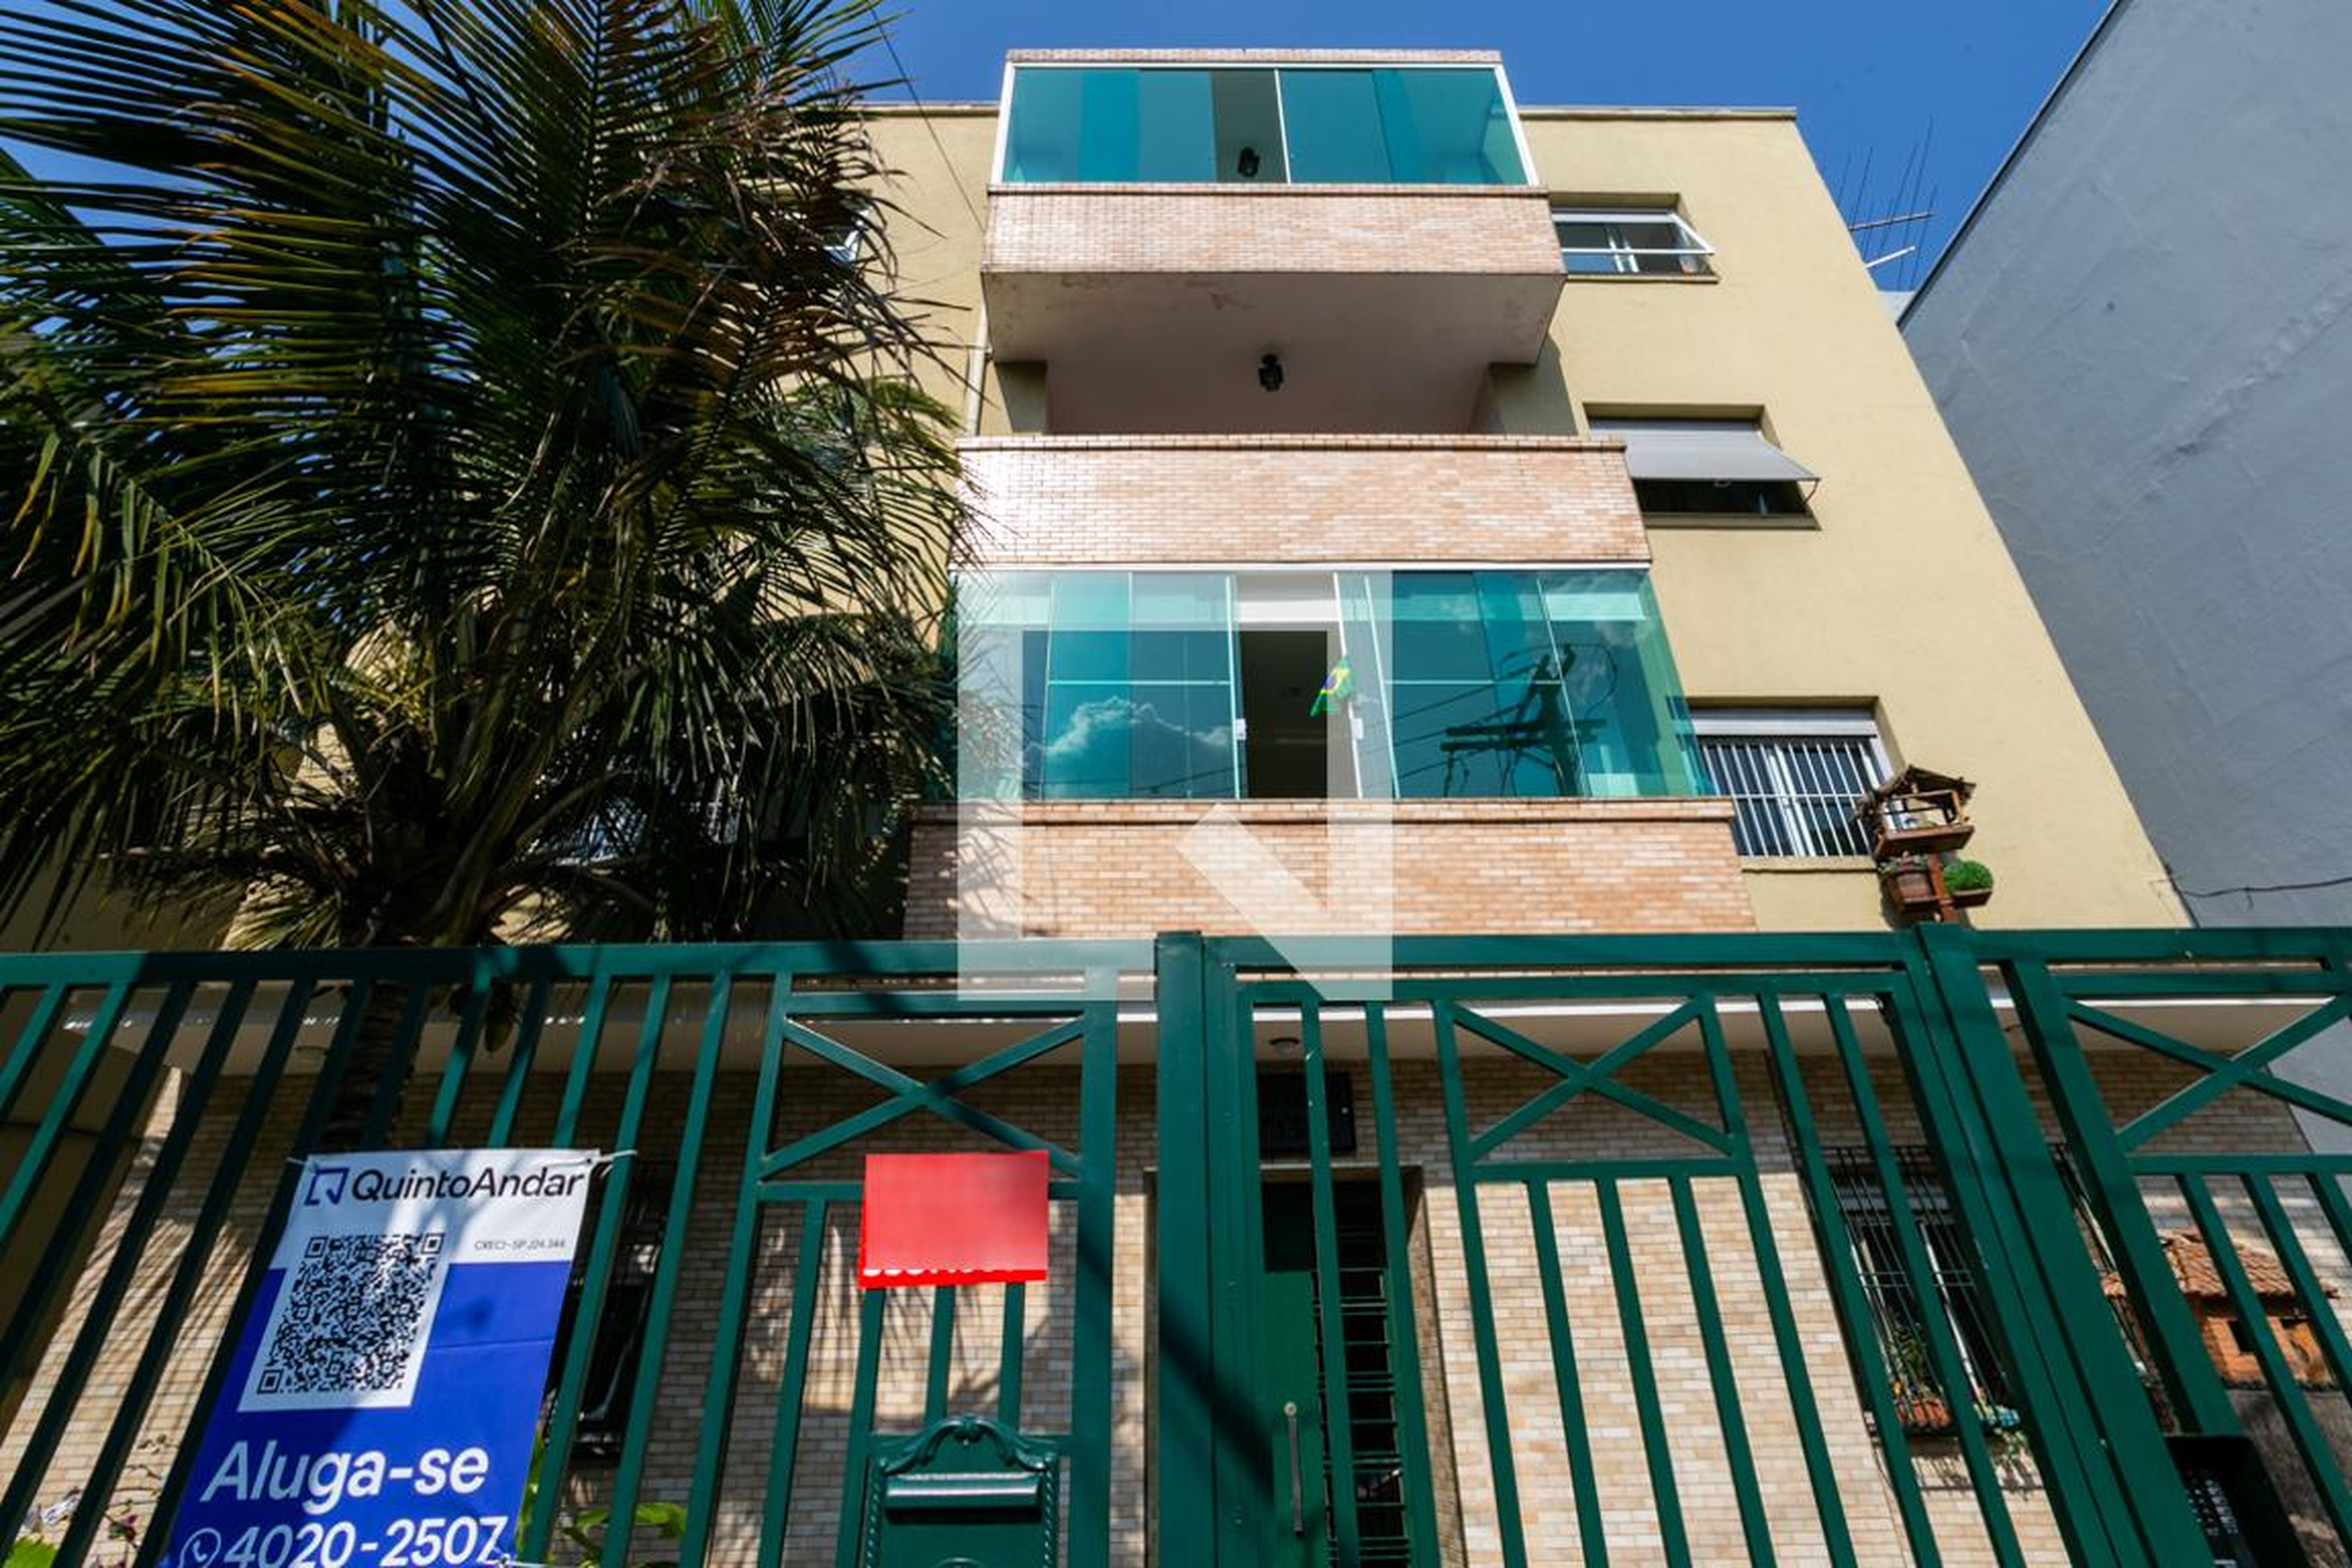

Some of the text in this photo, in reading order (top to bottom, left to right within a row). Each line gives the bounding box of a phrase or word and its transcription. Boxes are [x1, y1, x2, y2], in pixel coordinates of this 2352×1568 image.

[352, 1167, 584, 1202] QuintoAndar
[199, 1439, 489, 1515] Aluga-se
[224, 1516, 508, 1568] 4020-2507
